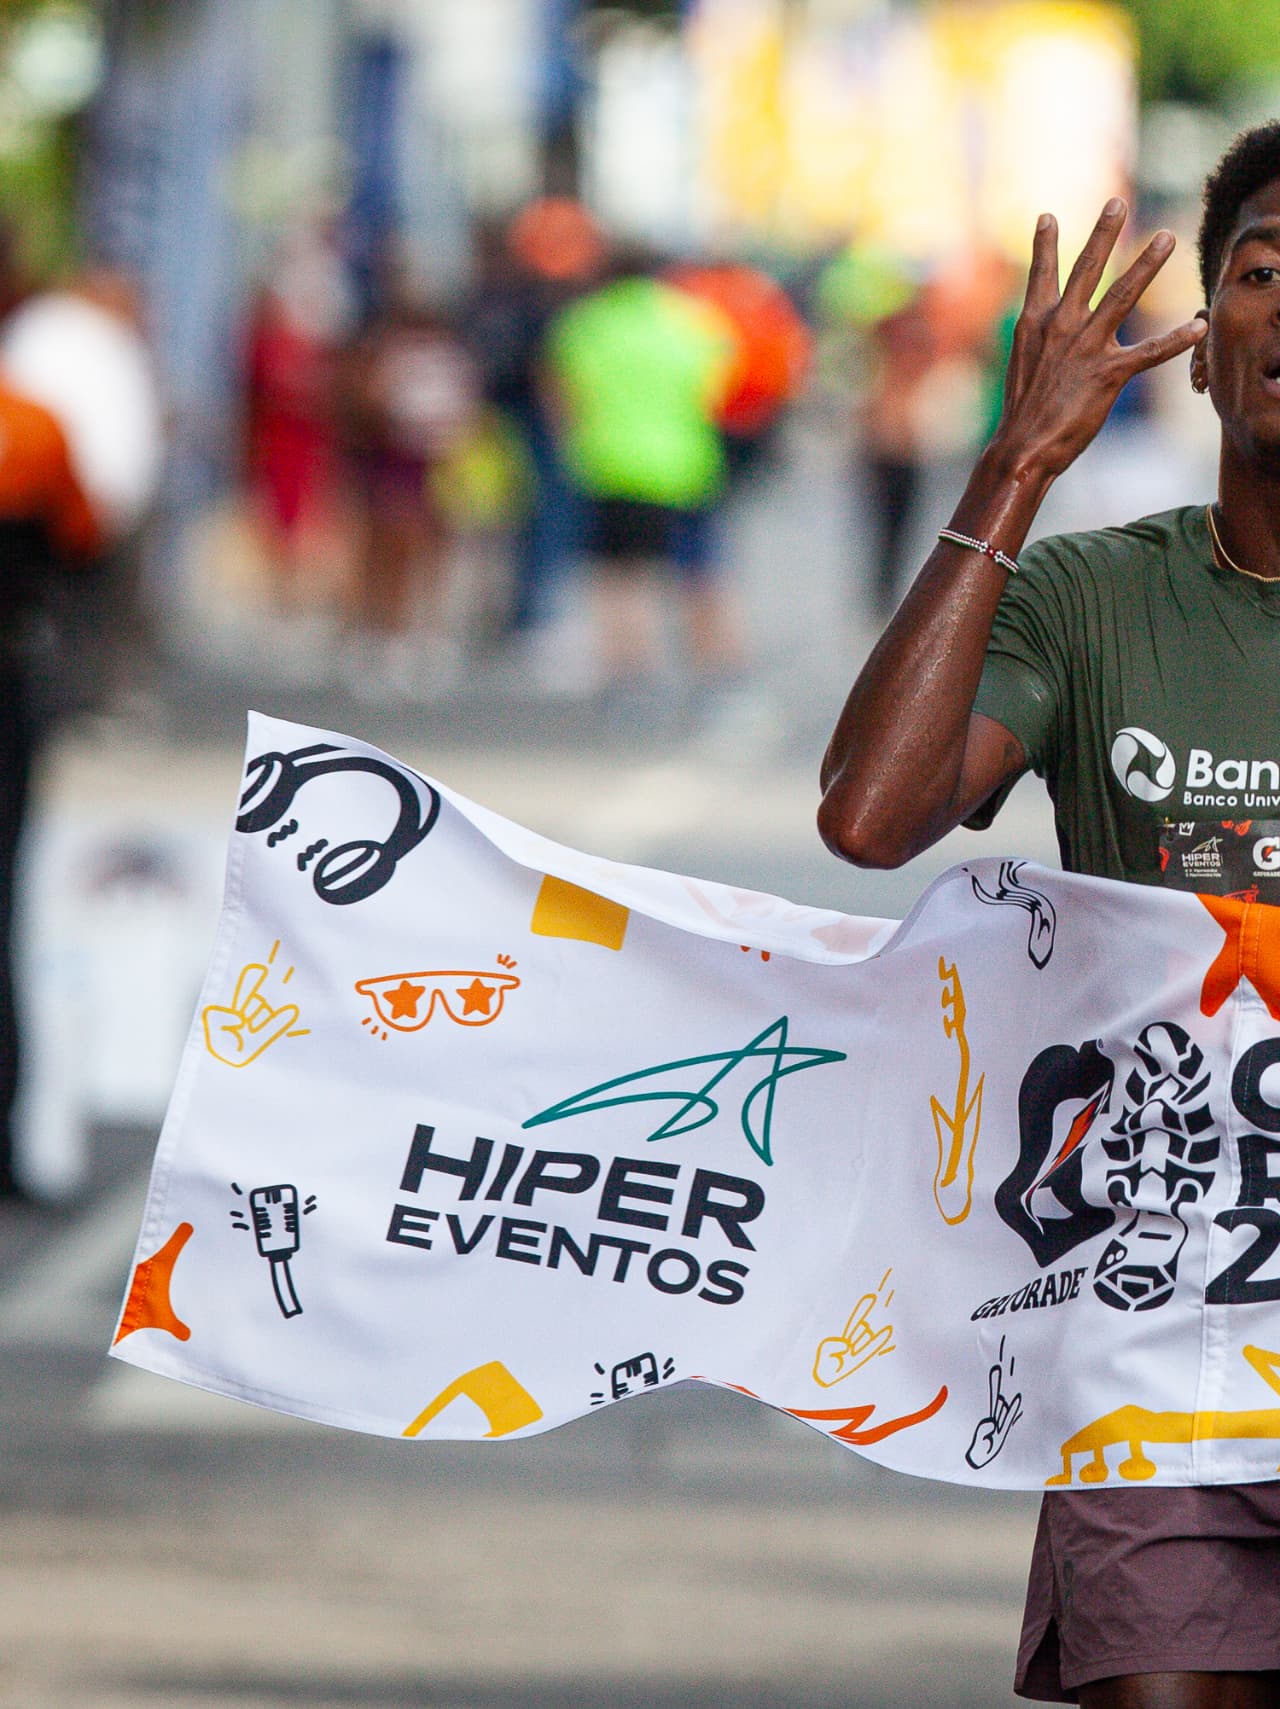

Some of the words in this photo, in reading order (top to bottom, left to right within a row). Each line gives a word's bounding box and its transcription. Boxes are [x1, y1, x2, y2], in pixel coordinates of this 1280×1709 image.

[1183, 791, 1238, 807] Banco
[1181, 853, 1221, 862] HIPER
[399, 1123, 766, 1252] HIPER
[386, 1203, 750, 1305] EVENTOS
[970, 1267, 1088, 1321] GATORADE
